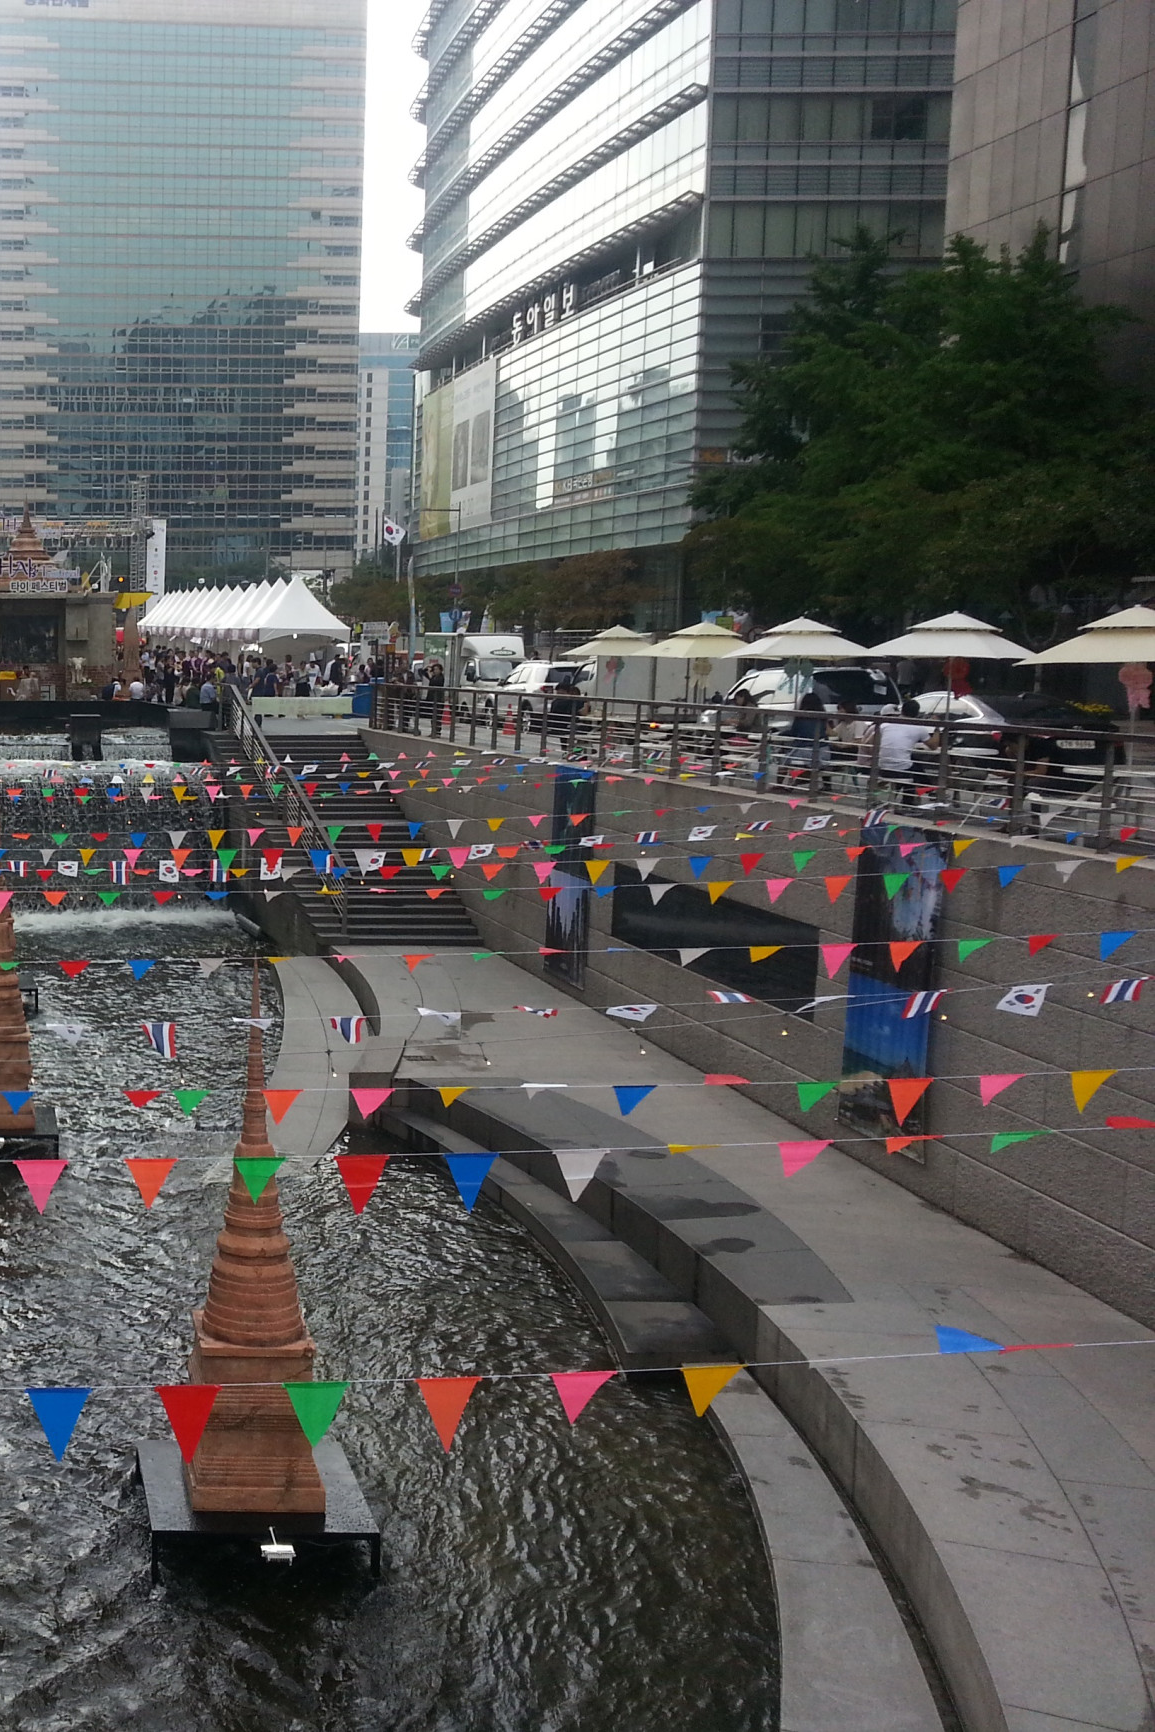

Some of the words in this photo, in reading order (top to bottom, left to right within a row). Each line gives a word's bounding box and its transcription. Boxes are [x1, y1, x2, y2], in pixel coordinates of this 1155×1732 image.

[510, 283, 576, 346] 동아일보
[11, 581, 29, 592] 타이
[31, 580, 67, 592] 페스티벌
